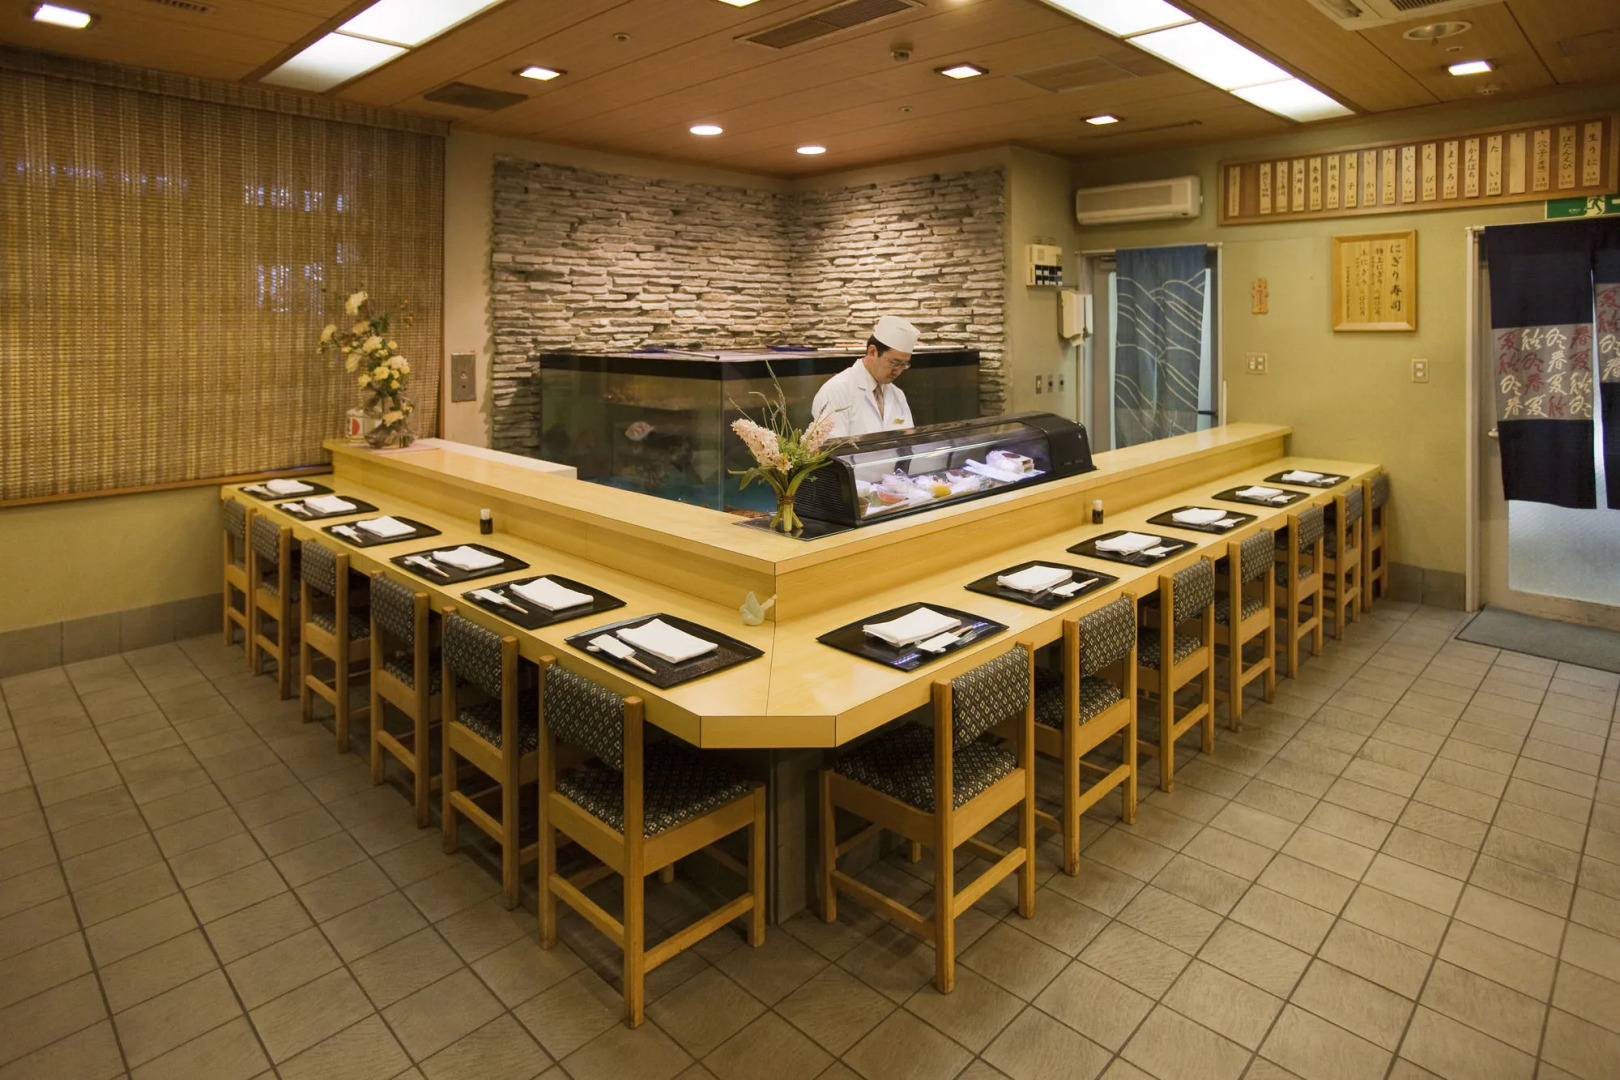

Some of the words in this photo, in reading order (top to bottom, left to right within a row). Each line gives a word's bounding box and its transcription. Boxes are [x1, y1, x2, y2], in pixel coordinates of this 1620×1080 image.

[1404, 154, 1413, 185] いくら
[1425, 153, 1434, 184] えび
[1447, 150, 1455, 182] まぐろ
[1490, 145, 1499, 177] たい
[1389, 244, 1403, 312] にぎり寿司
